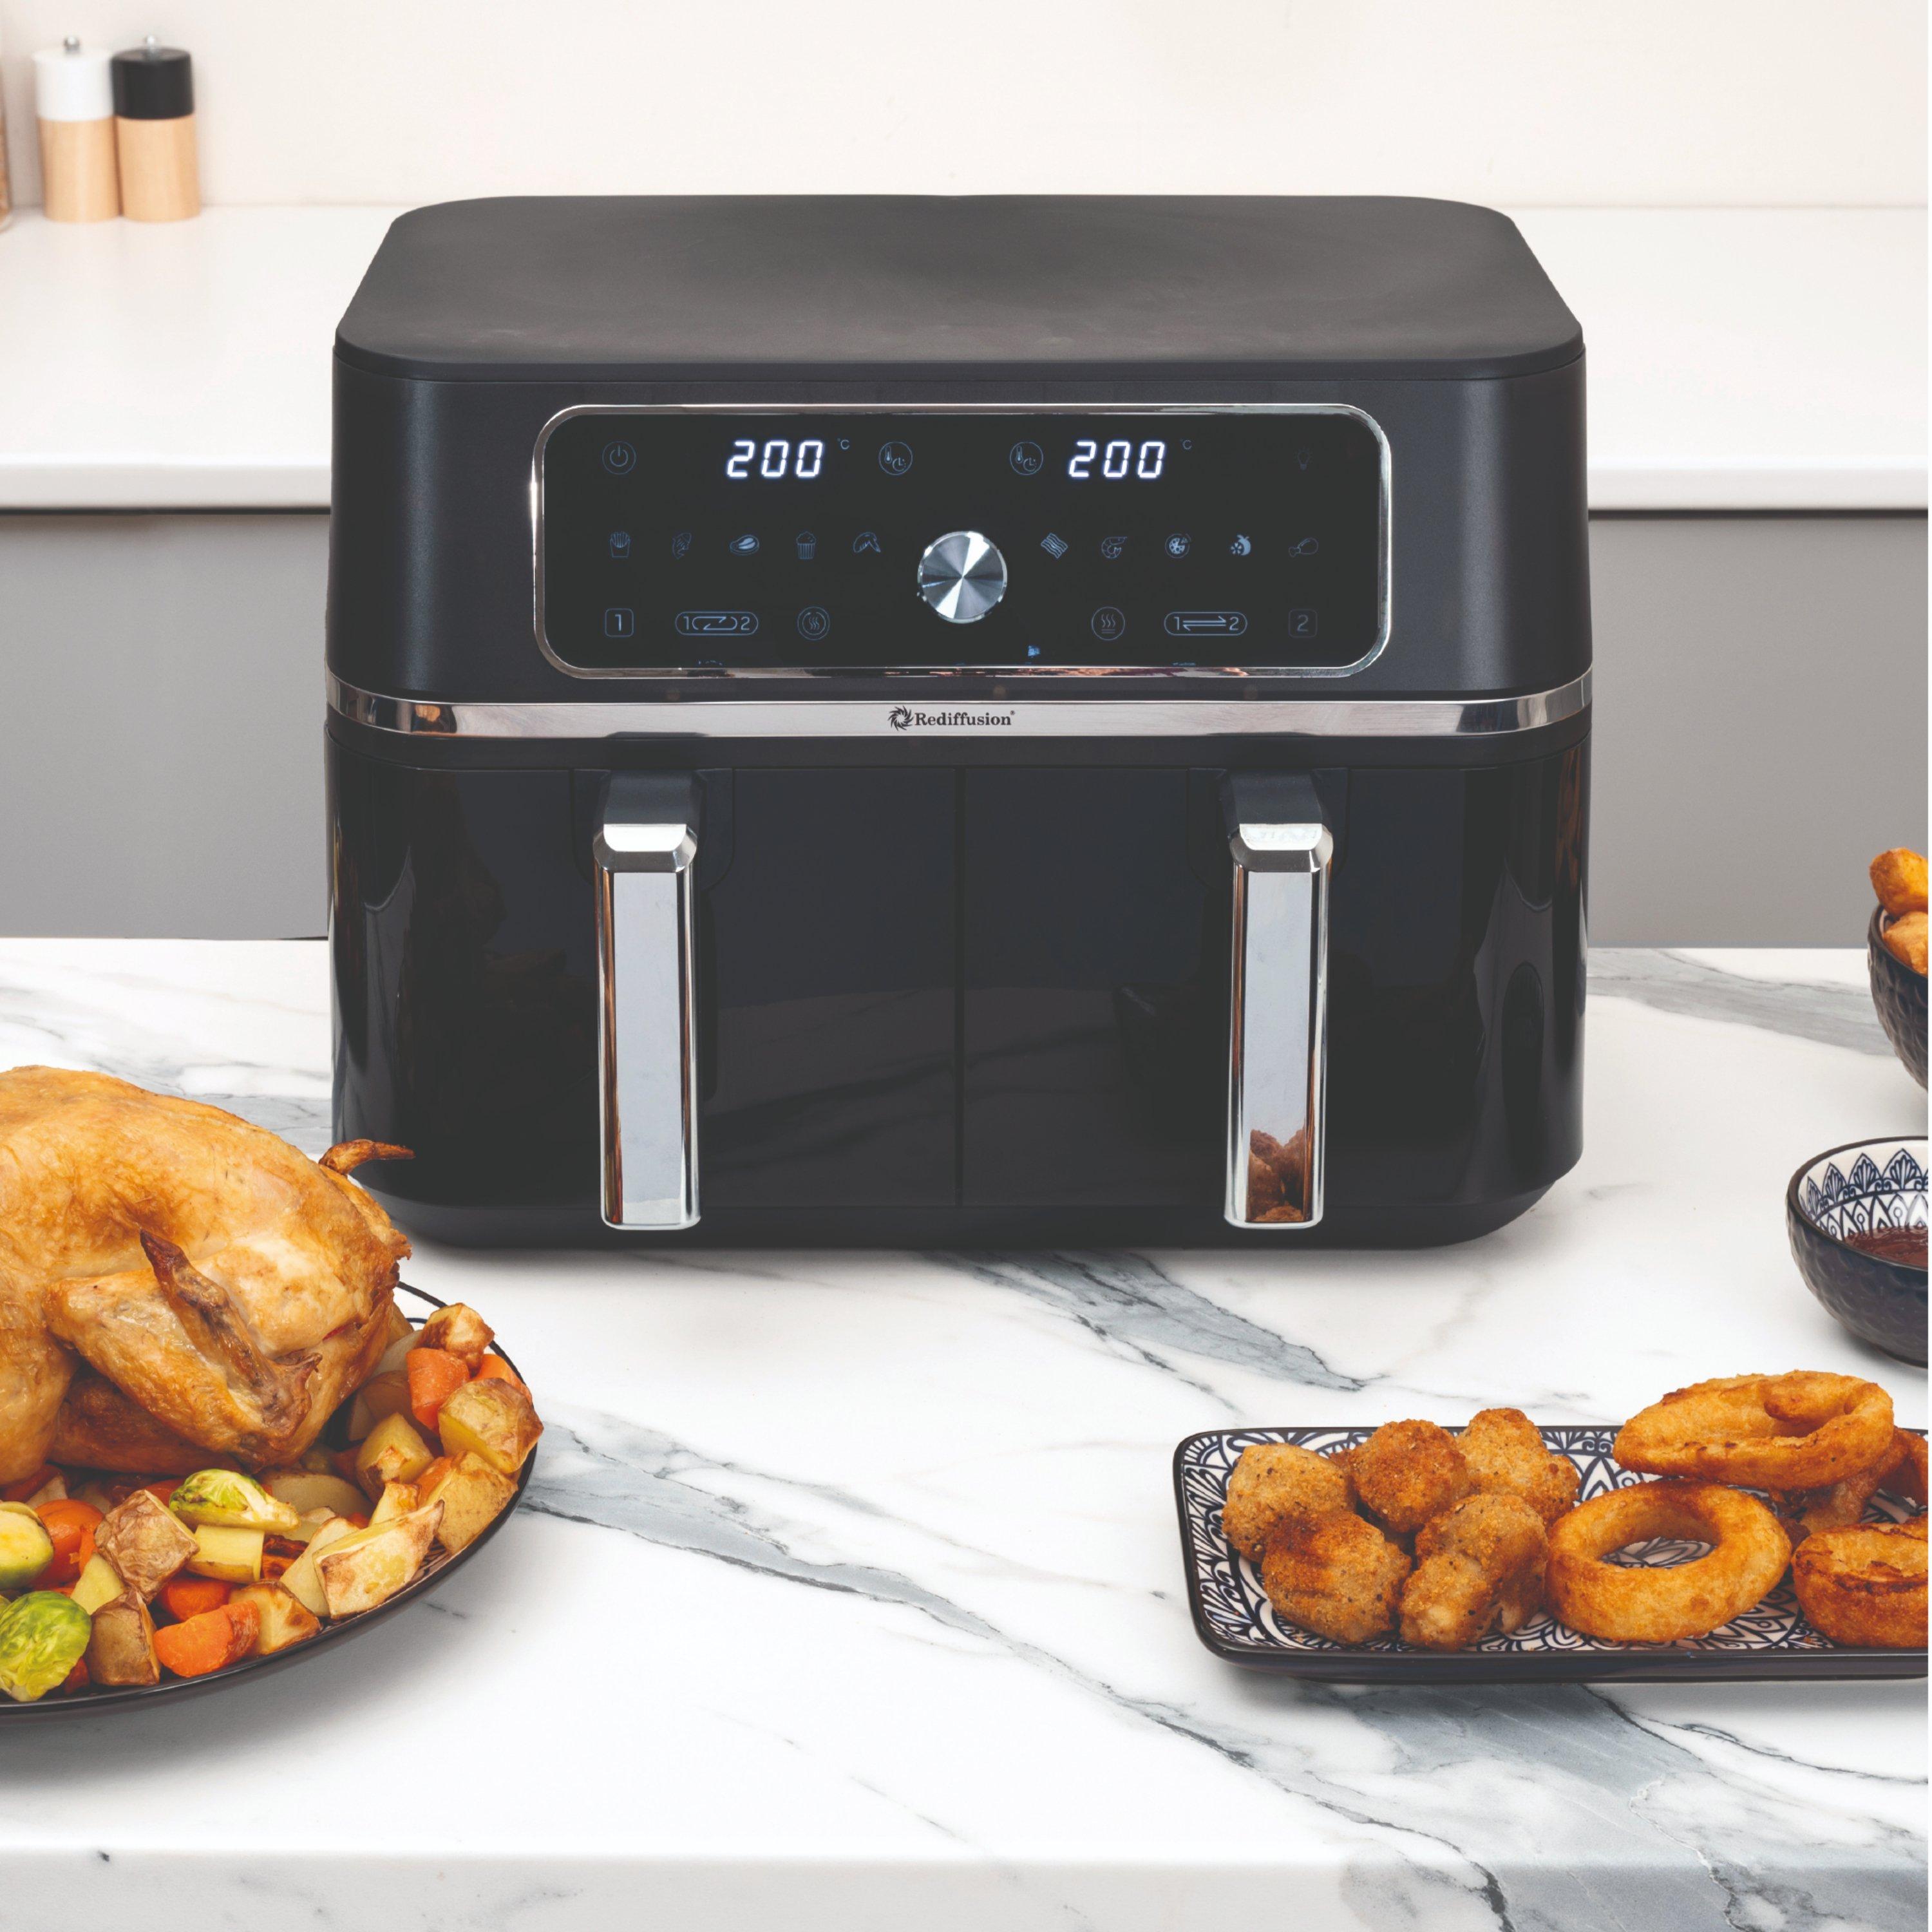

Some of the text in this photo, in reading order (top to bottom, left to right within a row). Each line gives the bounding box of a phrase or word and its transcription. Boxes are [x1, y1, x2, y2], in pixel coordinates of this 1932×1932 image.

[726, 440, 824, 478] 200
[1068, 440, 1166, 478] 200
[614, 614, 622, 632] 1
[1296, 614, 1309, 632] 2
